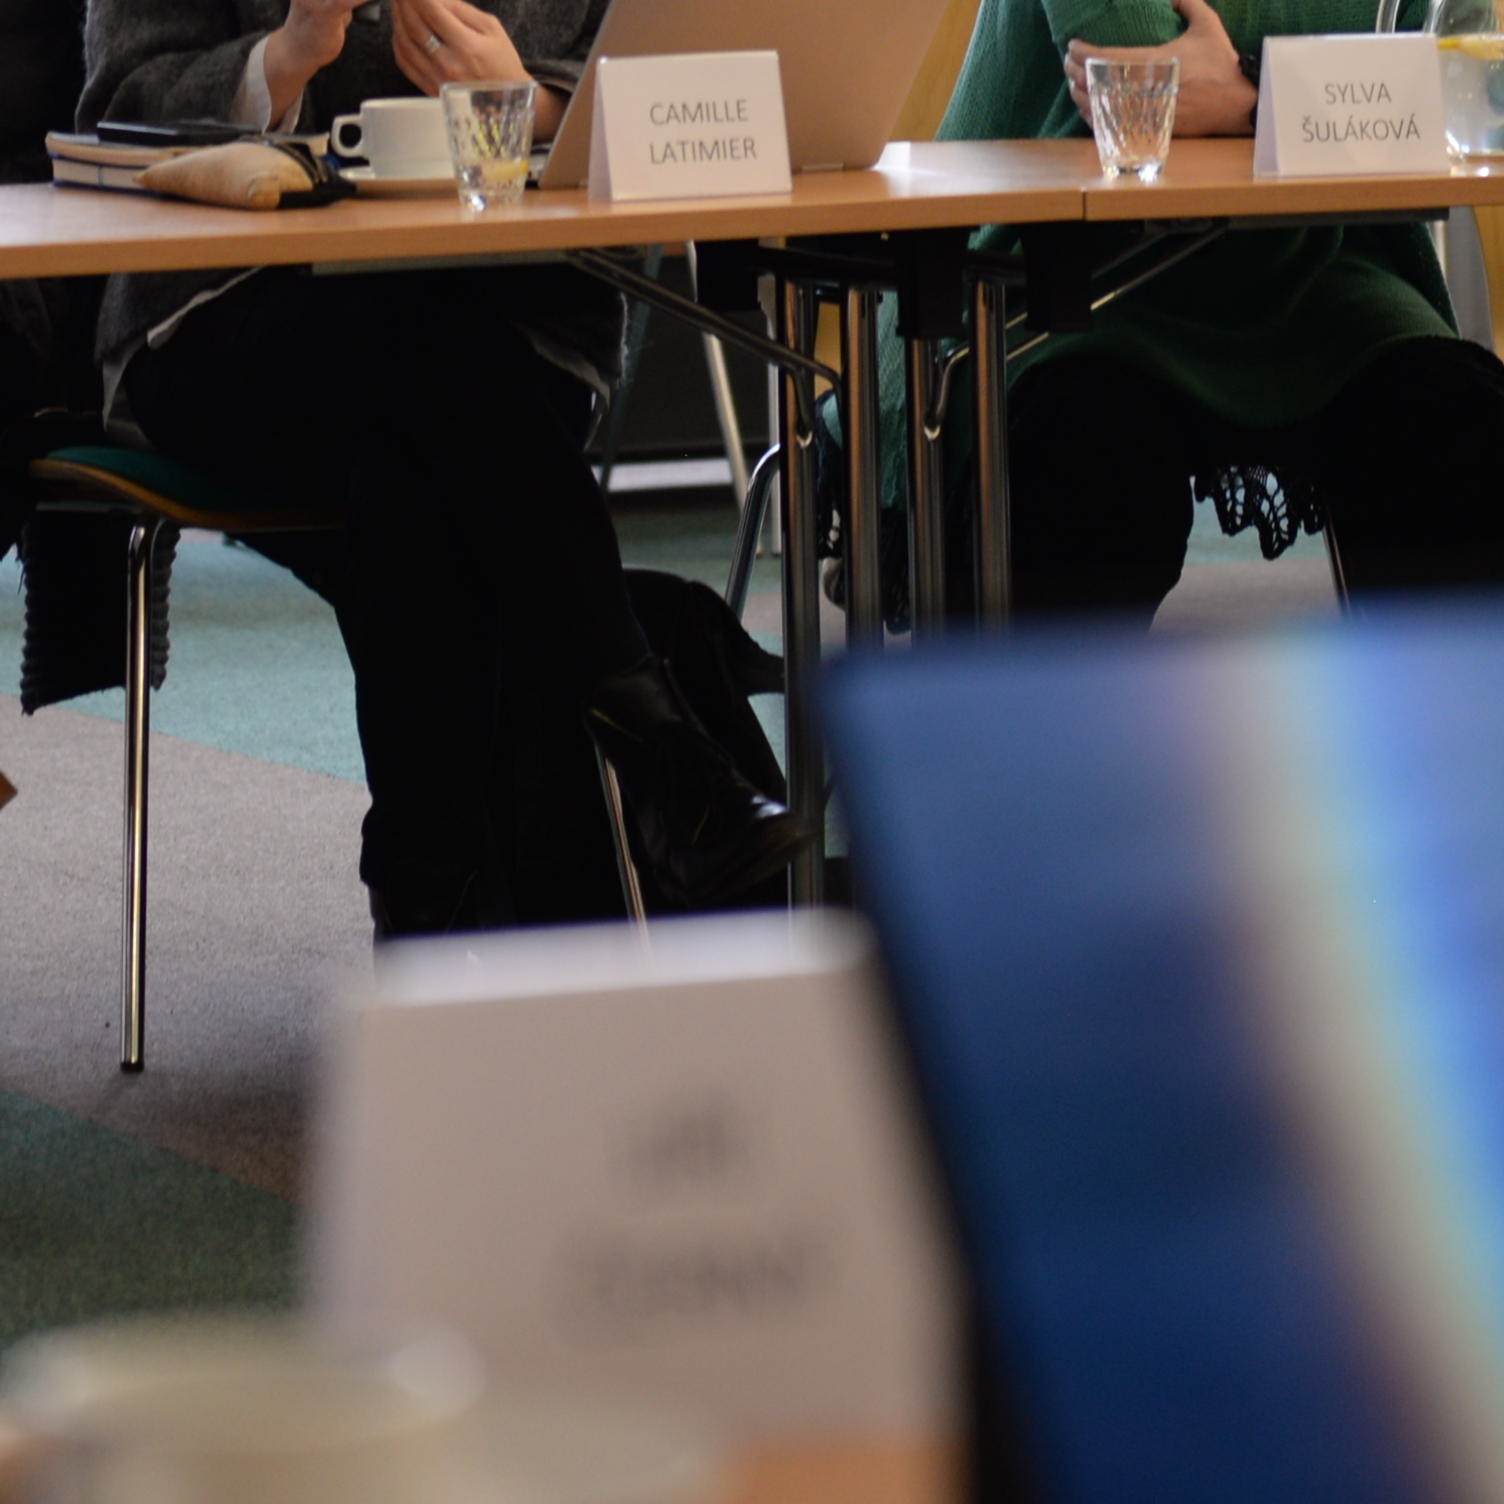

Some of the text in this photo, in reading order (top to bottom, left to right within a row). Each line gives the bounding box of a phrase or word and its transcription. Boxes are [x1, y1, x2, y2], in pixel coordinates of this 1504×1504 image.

[1324, 82, 1392, 105] SYLVA
[649, 99, 749, 125] CAMILLE
[1302, 113, 1421, 143] ŠULÁKOVÁ
[649, 137, 757, 165] LATIMIER
